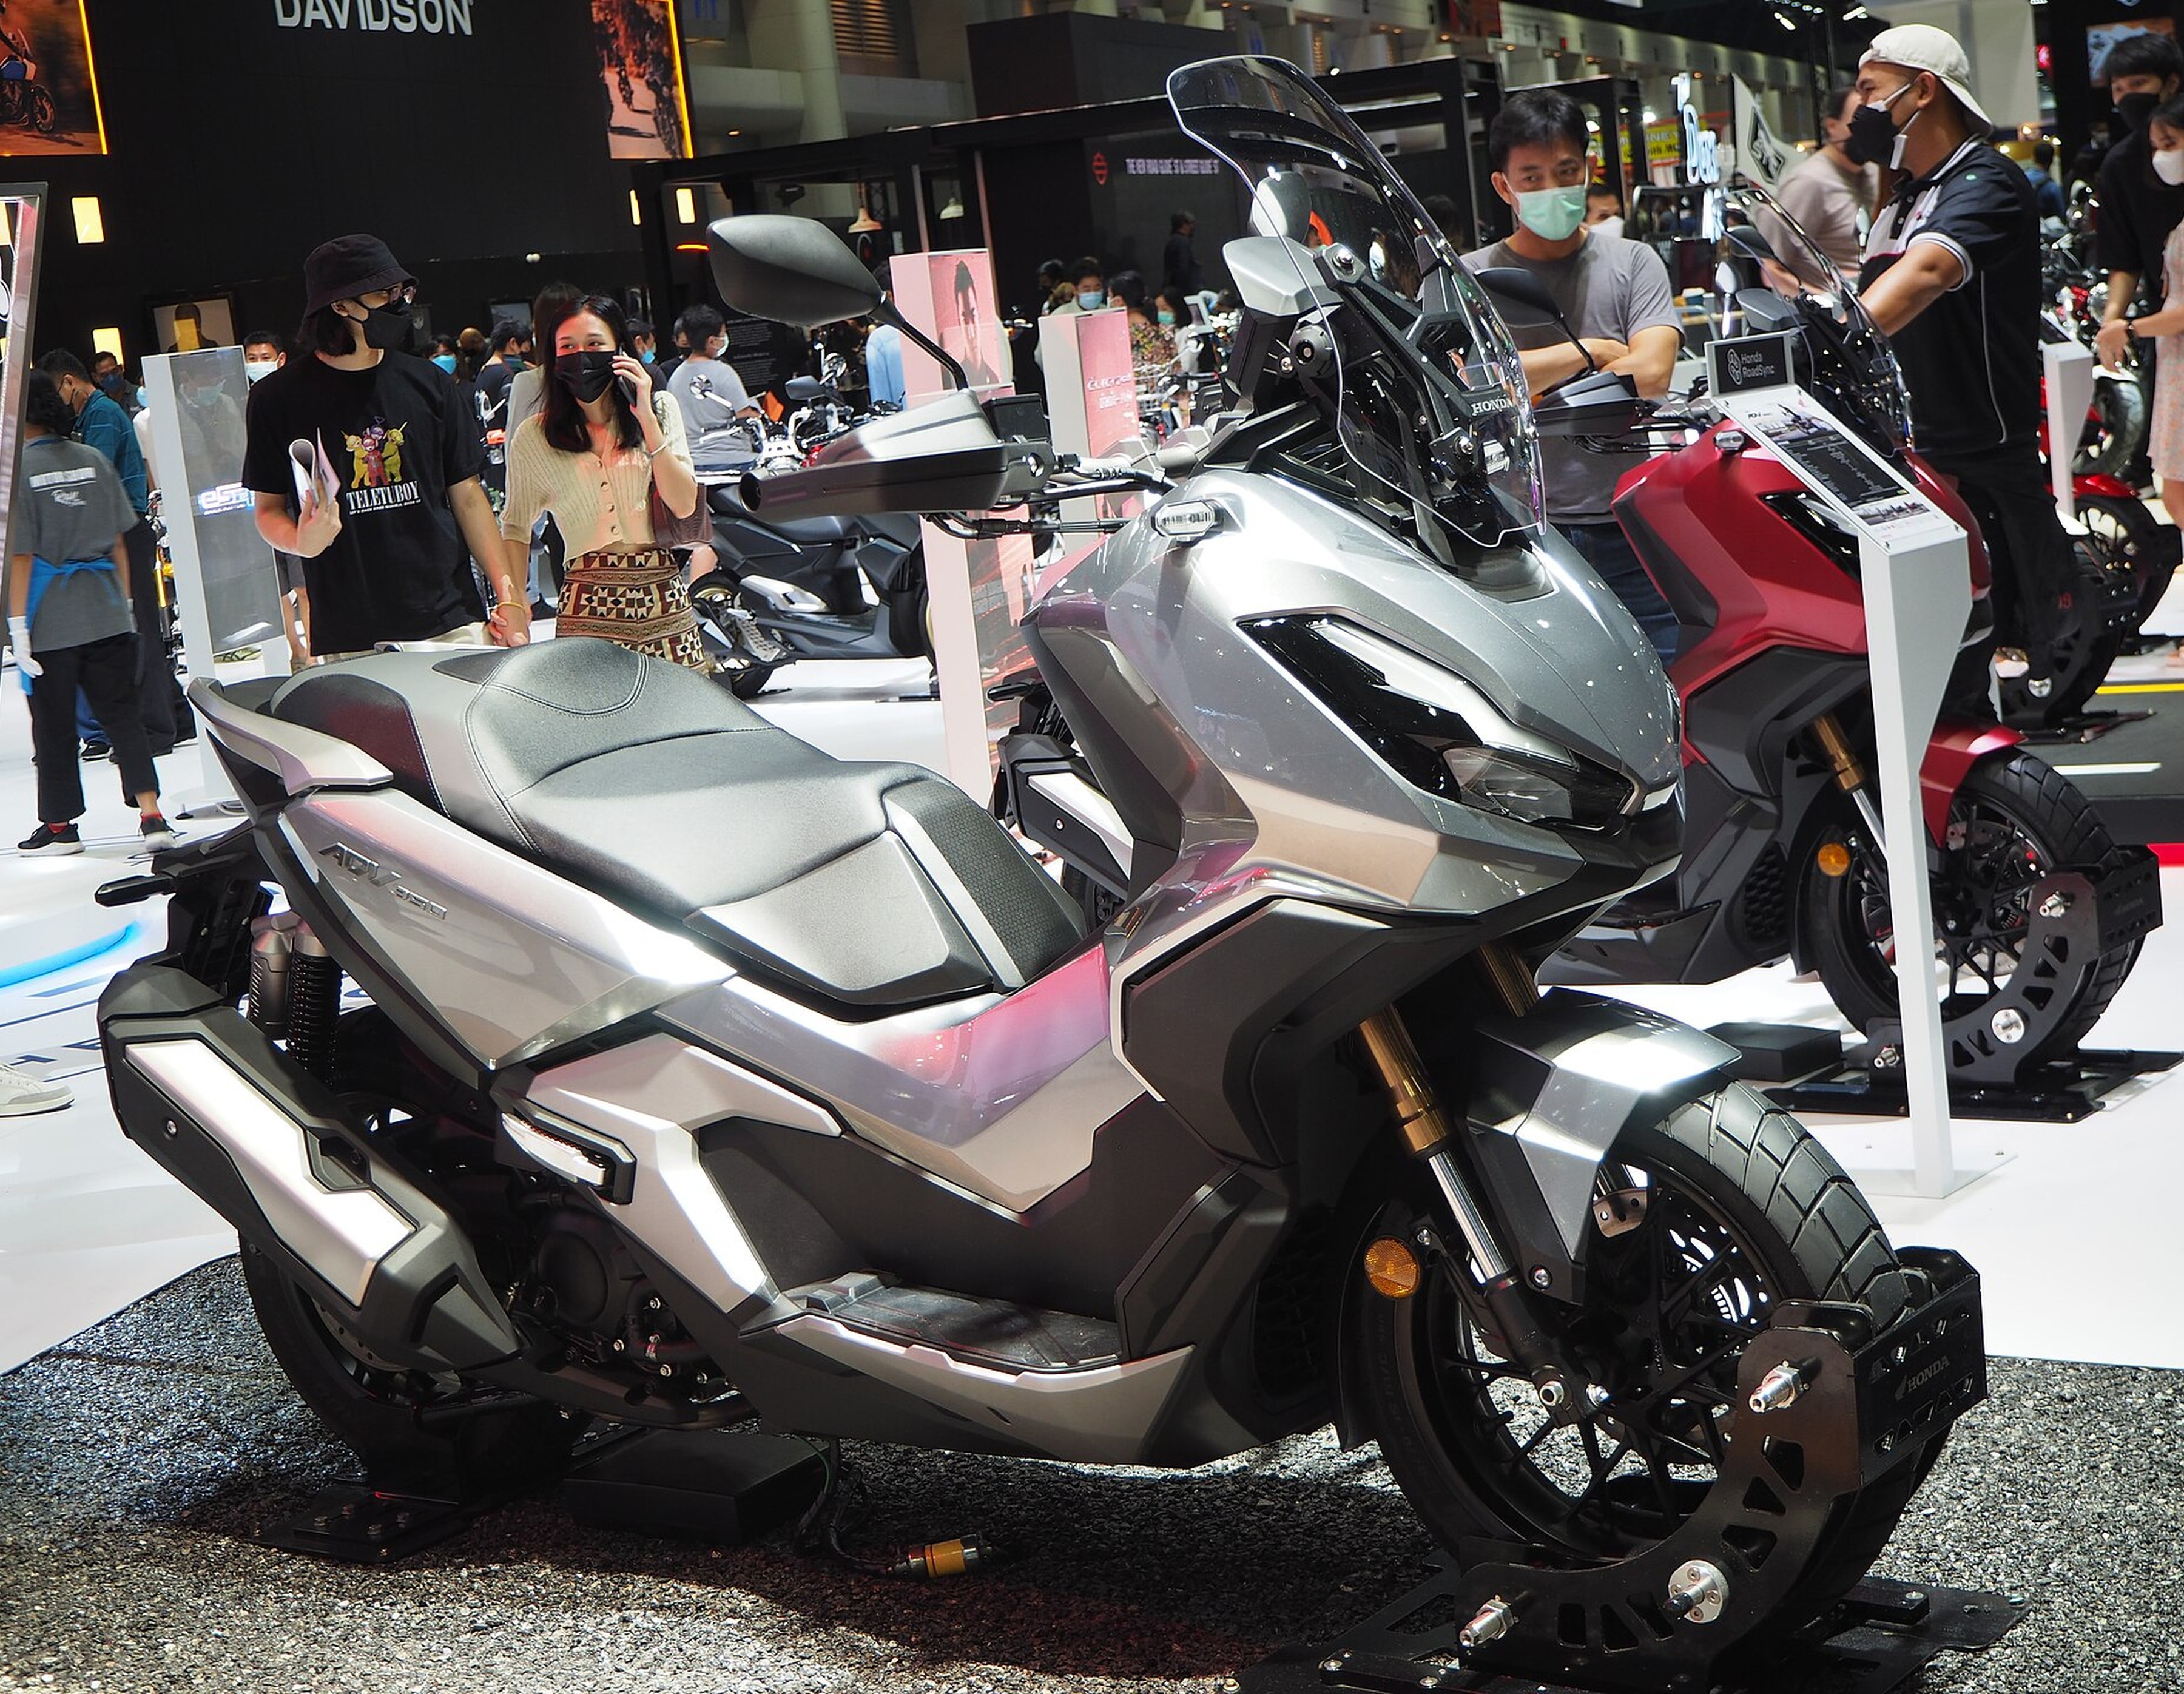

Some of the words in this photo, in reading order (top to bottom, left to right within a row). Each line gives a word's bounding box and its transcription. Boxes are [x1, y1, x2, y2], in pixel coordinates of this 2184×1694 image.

[274, 0, 473, 35] DAVIDSON
[1741, 351, 1762, 364] Honda
[1742, 364, 1775, 378] RoadSync
[1471, 397, 1514, 414] HONDA
[346, 481, 420, 510] TELETUBOY
[1907, 1355, 1950, 1393] HONDA
